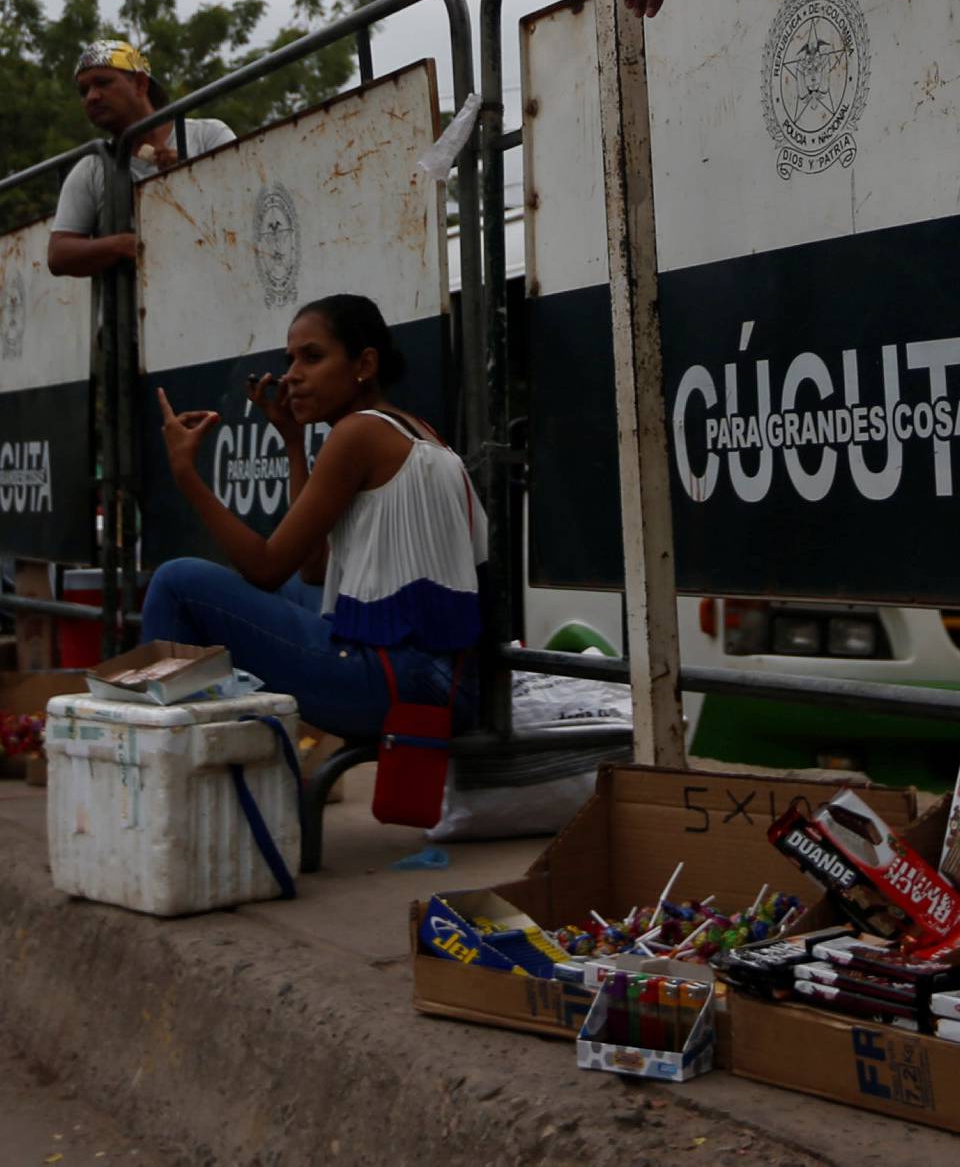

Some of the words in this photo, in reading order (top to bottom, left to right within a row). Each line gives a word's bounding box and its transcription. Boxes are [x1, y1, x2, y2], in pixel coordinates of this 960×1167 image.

[774, 14, 802, 77] REPUBLICA
[808, 3, 819, 15] DE
[826, 5, 855, 57] COLOMBIA
[818, 103, 850, 145] NACIONAL
[783, 149, 803, 168] DIOS
[808, 159, 815, 170] Y
[819, 136, 850, 168] PATRIA
[706, 415, 762, 449] PARA
[766, 405, 886, 447] GRANDES
[255, 457, 289, 479] GRAND
[786, 831, 857, 886] DUANDE
[883, 866, 951, 924] BLACK
[432, 932, 480, 965] Jet
